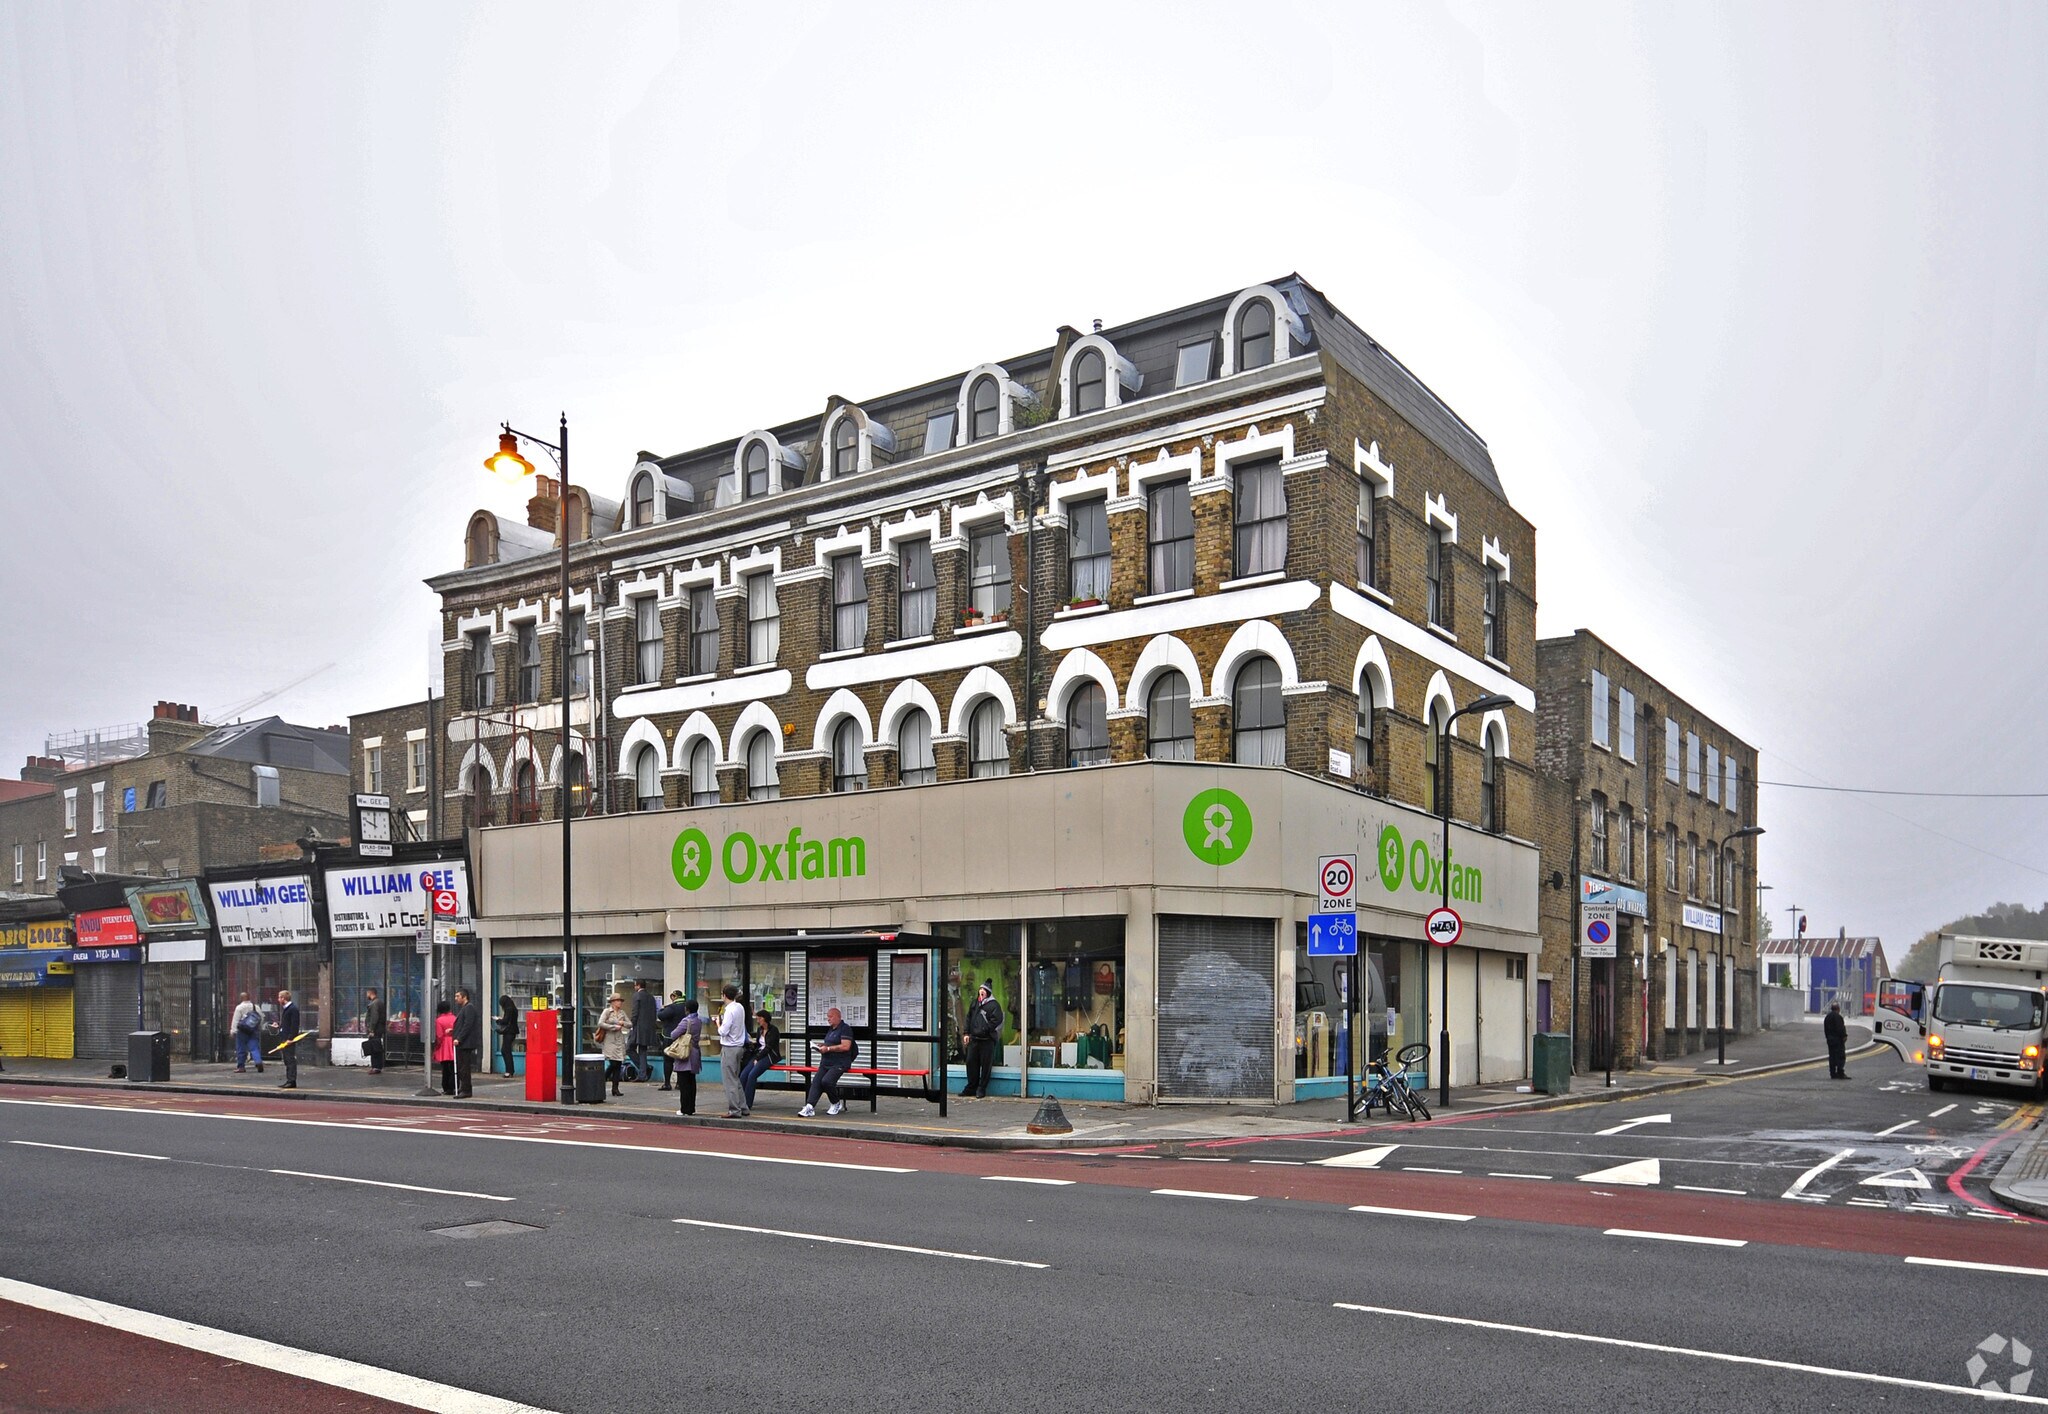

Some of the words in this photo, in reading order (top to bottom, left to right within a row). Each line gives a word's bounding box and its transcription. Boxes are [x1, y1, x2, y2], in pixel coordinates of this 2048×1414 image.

[722, 826, 866, 884] Oxfam
[342, 872, 413, 896] WILLIAM
[425, 875, 433, 887] D
[1327, 870, 1349, 886] 20
[217, 886, 277, 908] WILLIAM
[278, 884, 307, 903] GEE
[1323, 898, 1352, 909] ZONE
[101, 916, 122, 924] INTERNET
[334, 912, 365, 921] DISTRIBUTORS
[365, 912, 370, 920] &
[400, 911, 426, 927] Coa
[455, 916, 471, 925] DUCTS
[1685, 907, 1704, 926] WILLIAM
[1705, 913, 1714, 928] GEE
[80, 918, 101, 932] ANDU
[221, 925, 243, 933] STOCKISTS
[335, 923, 359, 932] STOCKISTS
[360, 922, 365, 931] OF
[367, 921, 375, 931] ALL
[273, 926, 293, 940] Sewing
[296, 928, 317, 937] PRODUCTS
